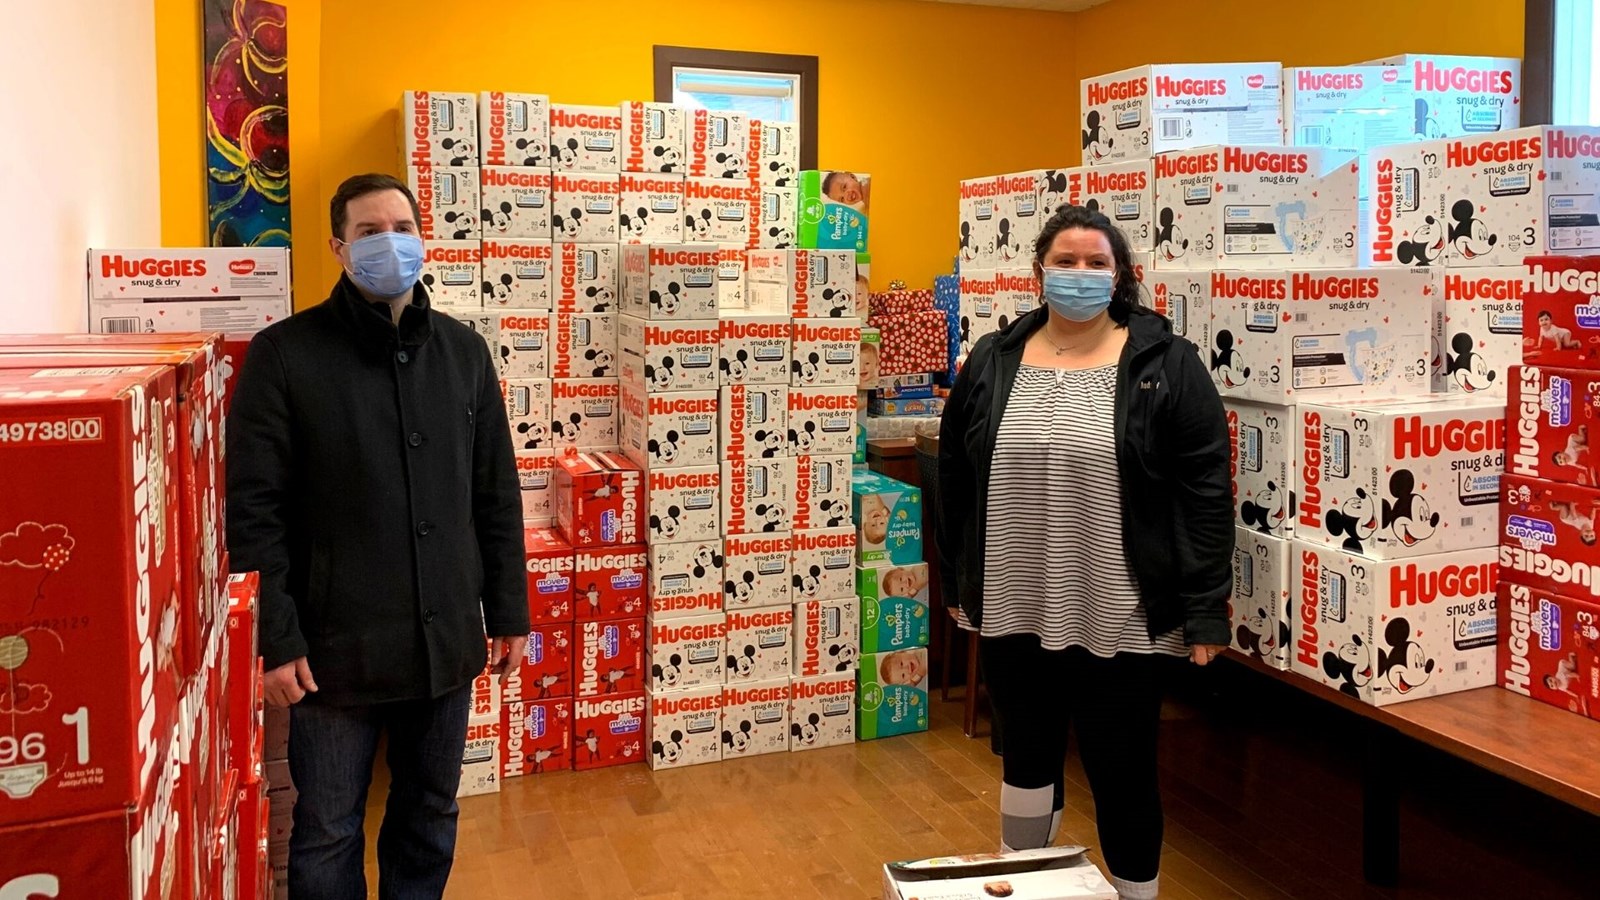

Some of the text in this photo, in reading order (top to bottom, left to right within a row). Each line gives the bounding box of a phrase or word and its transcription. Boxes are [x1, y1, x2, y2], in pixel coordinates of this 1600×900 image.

[1156, 76, 1226, 97] HUGGIES
[1298, 71, 1363, 91] HUGGIES
[1415, 61, 1512, 94] HUGGIES
[1088, 77, 1147, 106] HUGGIES
[1457, 98, 1478, 107] snug
[1489, 96, 1504, 108] dry
[412, 91, 431, 165] HUGGIES
[487, 92, 505, 165] HUGGIES
[550, 109, 622, 129] HUGGIES
[580, 130, 596, 138] snug
[627, 101, 644, 171] HUGGIES
[690, 109, 707, 177] HUGGIES
[748, 119, 761, 186] HUGGIES
[1447, 137, 1541, 168] HUGGIES
[1548, 131, 1600, 158] HUGG
[1156, 153, 1218, 178] HUGGIES
[1224, 147, 1307, 173] HUGGIES
[1424, 153, 1437, 165] 3
[1484, 166, 1506, 175] snug
[1516, 162, 1534, 172] dry
[482, 169, 551, 187] HUGGIES
[553, 176, 619, 193] HUGGIES
[620, 175, 684, 193] HUGGIES
[1088, 171, 1146, 194] HUGGIES
[1260, 176, 1277, 184] snug
[1286, 175, 1298, 184] dry
[1395, 167, 1403, 183] dry
[686, 181, 751, 200] HUGGIES
[960, 182, 996, 199] HUGGIES
[997, 176, 1034, 195] HUGGIE
[746, 186, 761, 249] HUGGIES
[1373, 159, 1393, 261] HUGGIES
[832, 207, 843, 240] Pampers
[1345, 232, 1354, 248] 3
[1523, 227, 1536, 245] 3
[482, 242, 551, 258] HUGGIES
[650, 249, 719, 266] HUGGIES
[102, 255, 207, 277] HUGGIES
[131, 279, 154, 287] snug
[164, 278, 181, 287] dry
[558, 242, 576, 312] HUGGIES
[792, 250, 808, 318] HUGGIES
[960, 277, 995, 295] HUGGIES
[1212, 273, 1285, 299] HUGGIES
[1292, 273, 1378, 300] HUGGIES
[1523, 265, 1600, 294] HUGG
[1446, 275, 1523, 300] HUGGIE
[708, 300, 715, 308] 4
[1329, 303, 1347, 311] snug
[1357, 301, 1369, 310] dry
[645, 326, 719, 345] HUGGIES
[719, 320, 791, 338] HUGGIES
[793, 324, 860, 342] HUGGIES
[554, 313, 570, 378] HUGGIES
[849, 368, 856, 377] 4
[1270, 366, 1279, 383] 3
[1417, 359, 1425, 375] 3
[553, 382, 619, 398] HUGGIES
[649, 397, 717, 414] HUGGIES
[789, 393, 857, 410] HUGGIES
[1551, 377, 1560, 425] movers
[727, 384, 744, 460] HUGGIES
[1354, 418, 1368, 431] 3
[1514, 366, 1540, 476] HUGGIES
[1323, 424, 1331, 443] dry
[1394, 416, 1505, 459] HUGGIE
[1300, 412, 1321, 528] HUGGIES
[1324, 456, 1332, 482] snug
[1451, 457, 1481, 472] snug
[651, 473, 719, 490] HUGGIES
[728, 460, 745, 534] HUGGIES
[793, 456, 810, 529] HUGGIES
[1508, 490, 1518, 504] 3
[622, 471, 639, 544] HUGGIES
[793, 534, 856, 550] HUGGIES
[889, 528, 920, 540] Pampers
[1508, 526, 1555, 544] movers
[726, 538, 792, 556] HUGGIES
[576, 554, 646, 572] HUGGIES
[1351, 564, 1365, 579] 3
[537, 577, 569, 587] movers
[612, 573, 642, 582] movers
[1320, 565, 1329, 585] dry
[1390, 563, 1499, 608] HUGGIE
[654, 592, 721, 612] HUGGIES
[1298, 550, 1319, 668] HUGGIES
[1321, 597, 1329, 624] snug
[1446, 602, 1475, 616] snug
[726, 610, 792, 630] HUGGIES
[867, 608, 874, 619] 12
[1578, 611, 1592, 625] 3
[653, 624, 726, 644] HUGGIES
[892, 604, 903, 645] Pampers
[1540, 601, 1550, 648] movers
[803, 600, 819, 676] HUGGIES
[1505, 584, 1531, 696] HUGGIES
[580, 622, 598, 696] HUGGIES
[714, 666, 721, 675] 4
[723, 686, 789, 706] HUGGIES
[791, 679, 855, 699] HUGGIES
[575, 697, 644, 719] HUGGIES
[654, 696, 722, 716] HUGGIES
[892, 687, 901, 722] Pampers
[610, 718, 640, 728] movers
[62, 707, 89, 765] 1
[505, 702, 524, 777] HUGGIES
